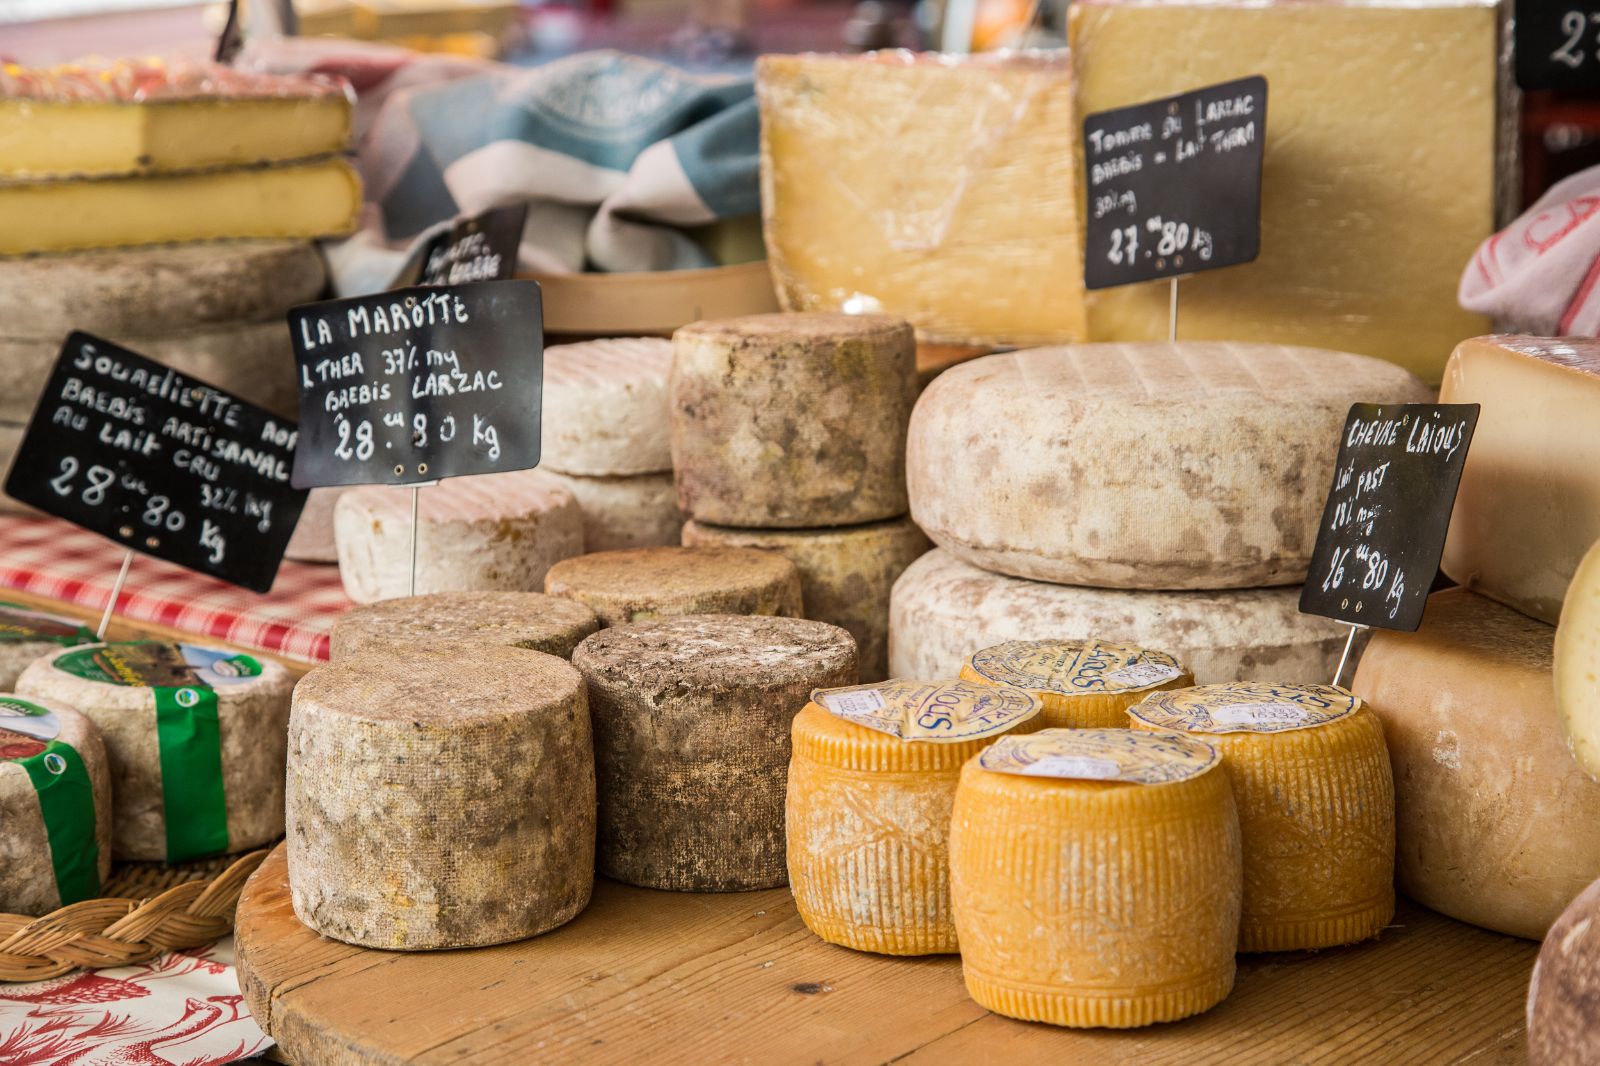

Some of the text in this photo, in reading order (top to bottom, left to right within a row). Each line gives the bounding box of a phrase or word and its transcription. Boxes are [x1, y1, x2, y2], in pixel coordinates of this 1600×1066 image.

[1195, 94, 1254, 127] LARZAC
[300, 292, 469, 350] LA MAROTTE
[381, 338, 419, 375] 37%
[411, 369, 503, 399] LARZAC
[172, 450, 222, 482] CRU
